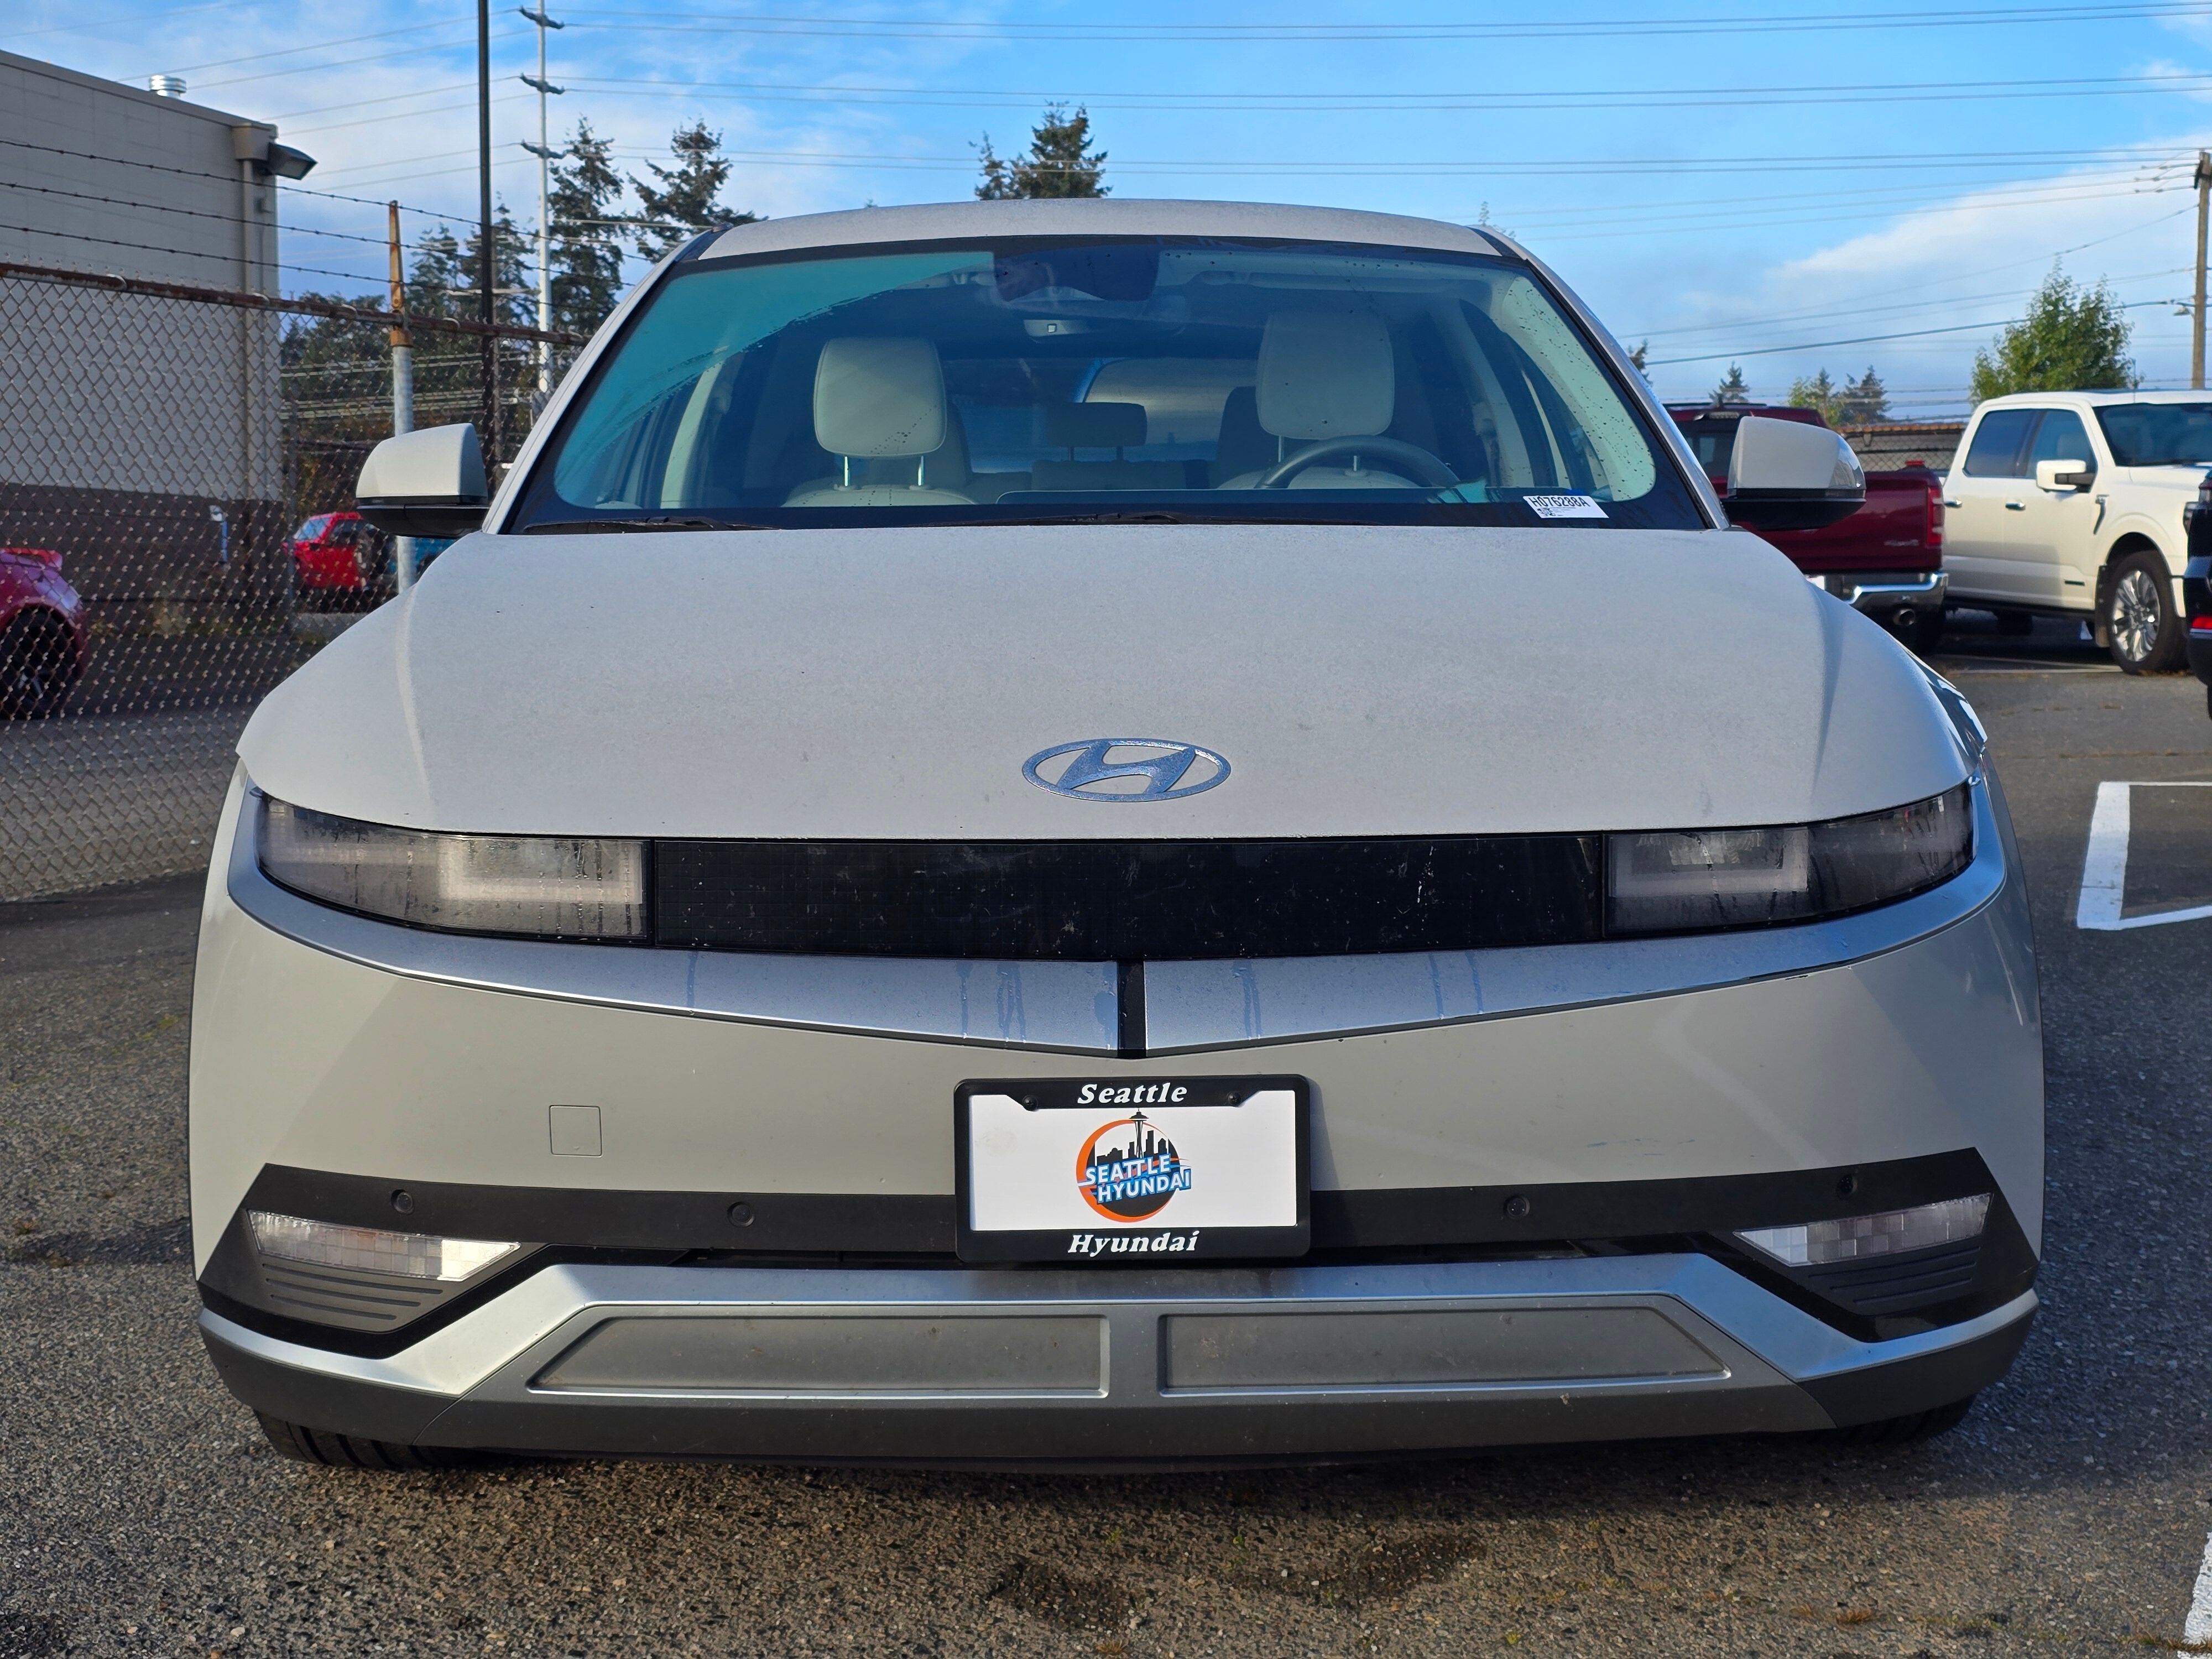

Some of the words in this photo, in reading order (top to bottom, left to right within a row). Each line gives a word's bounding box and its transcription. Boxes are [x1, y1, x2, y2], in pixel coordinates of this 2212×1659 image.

[1077, 1082, 1187, 1104] Seattle
[1078, 1154, 1171, 1186] SEATTLE
[1098, 1170, 1191, 1202] HYUNDAI
[1067, 1230, 1200, 1258] Hyundai
